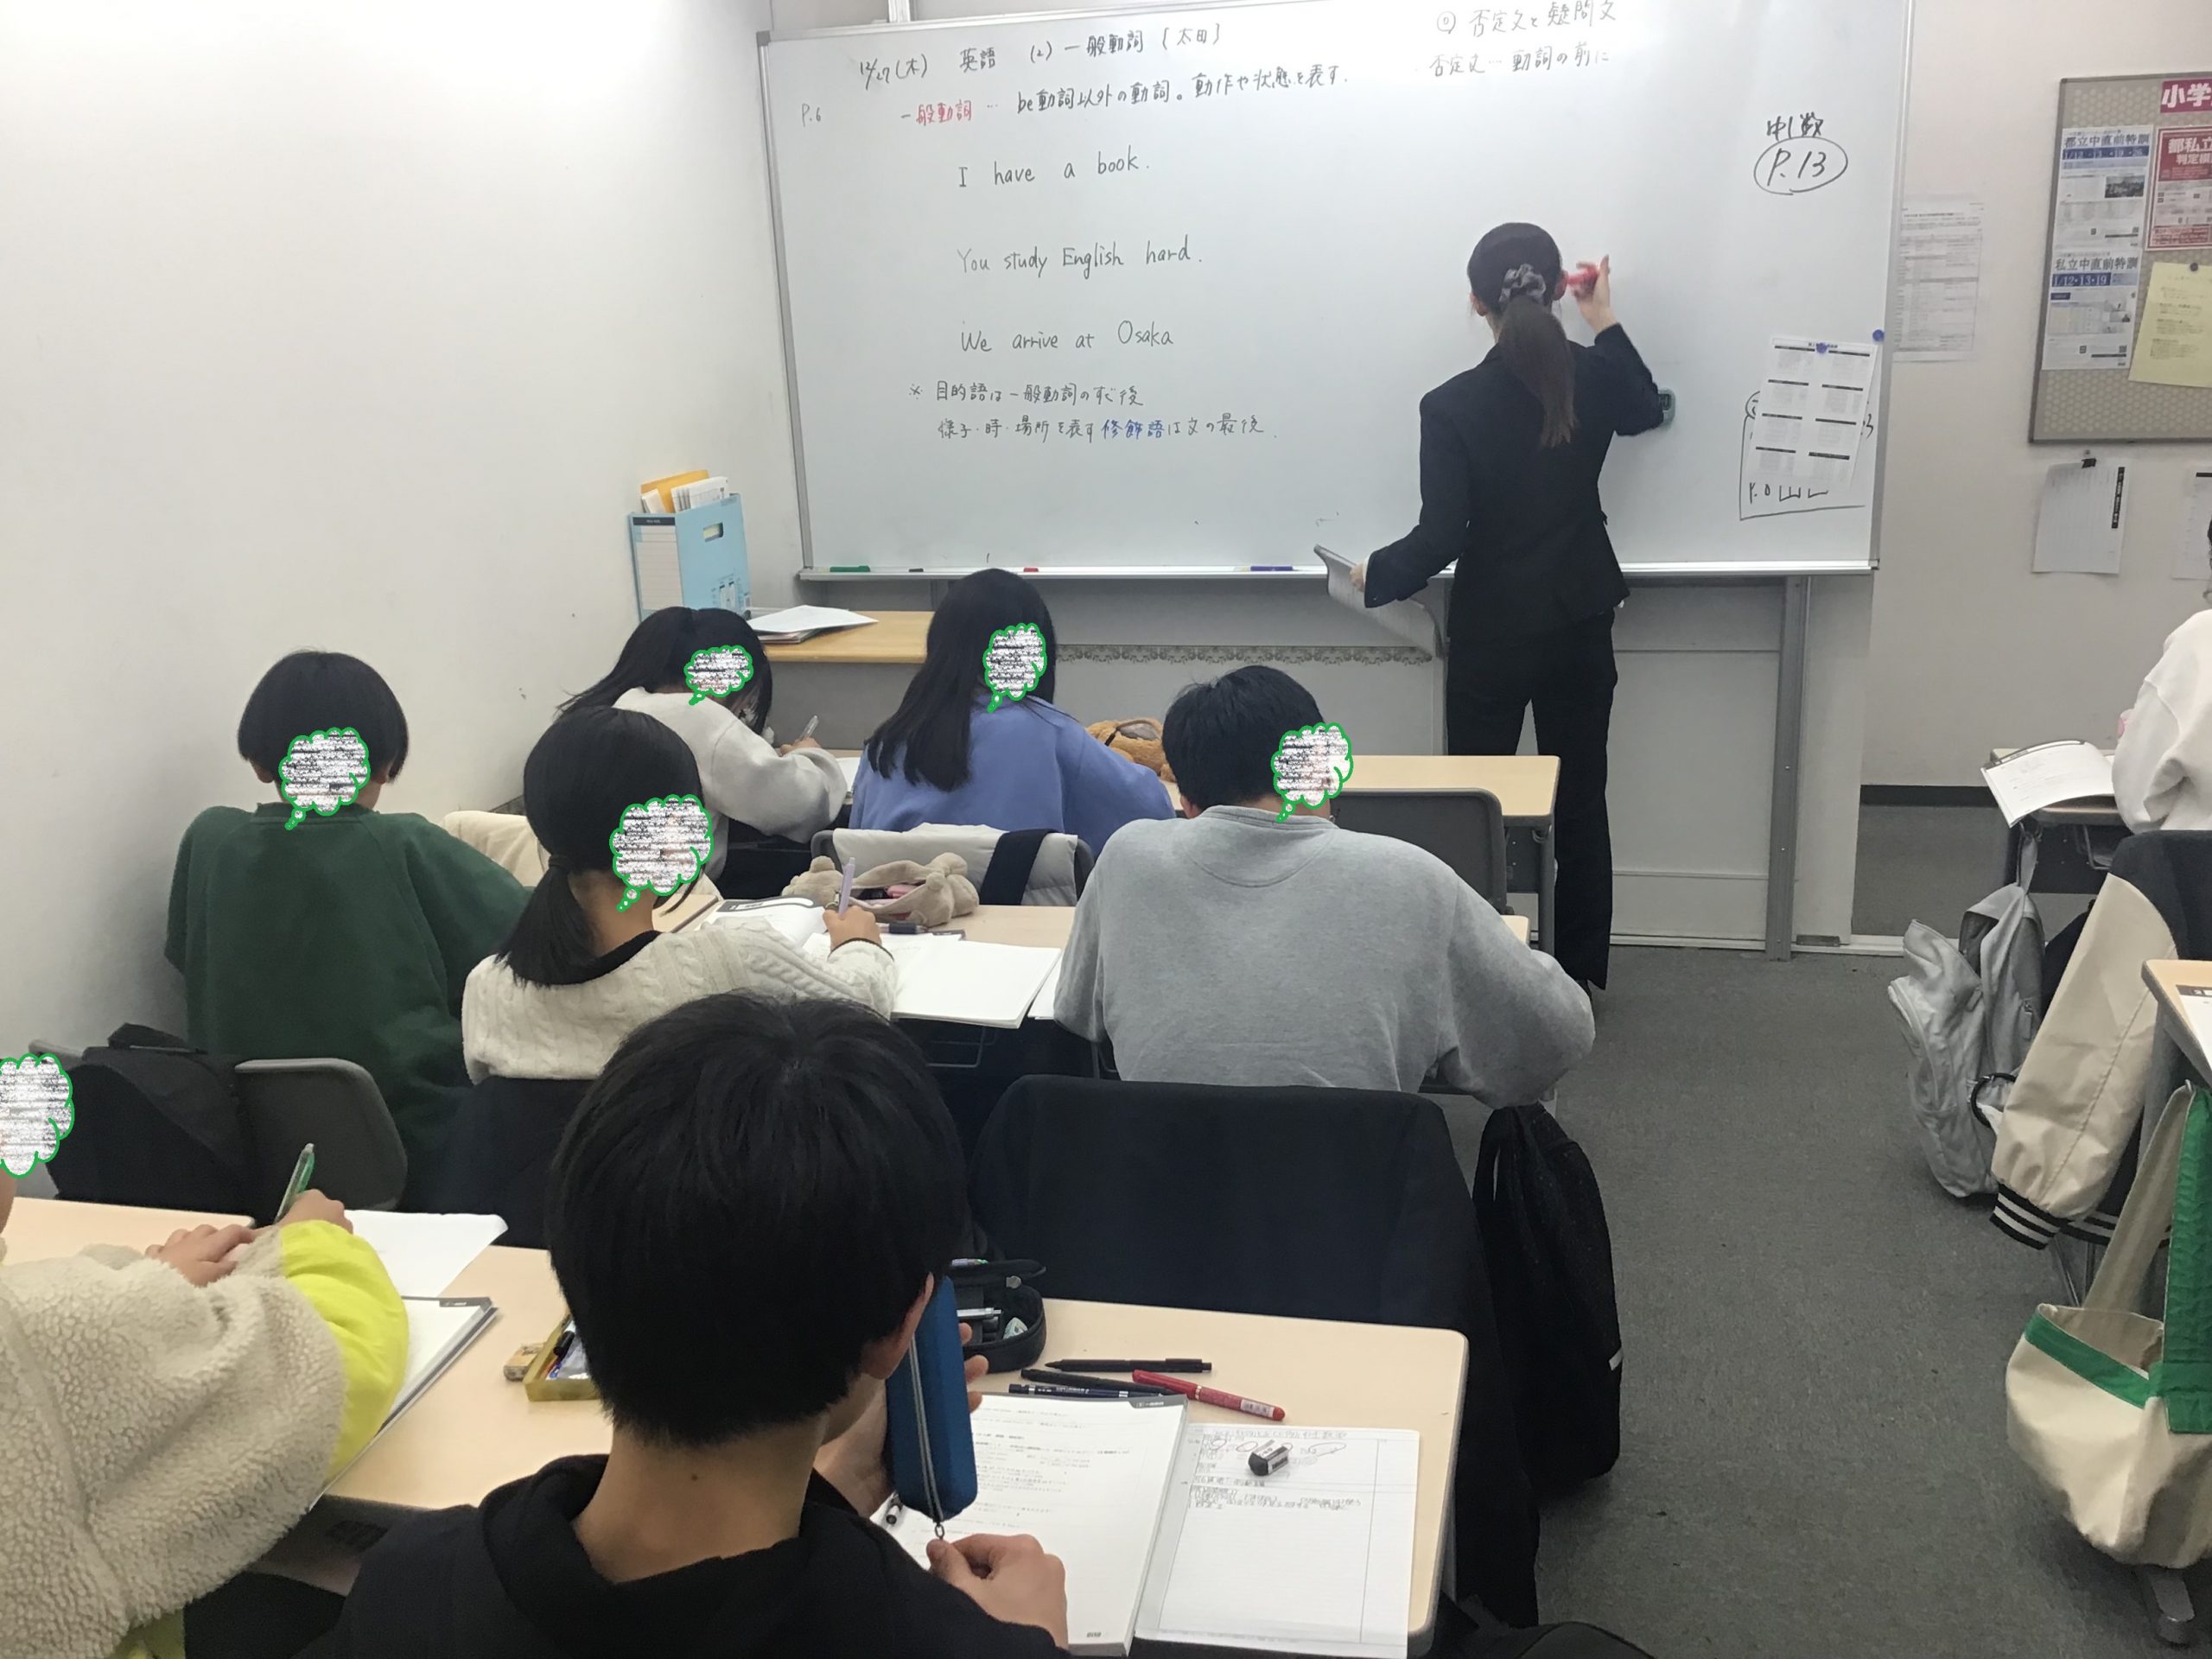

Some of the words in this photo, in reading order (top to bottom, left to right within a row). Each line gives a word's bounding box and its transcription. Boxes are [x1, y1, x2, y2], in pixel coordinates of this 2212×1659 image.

[960, 48, 995, 73] 英語
[1064, 30, 1144, 58] 一般動詞
[2162, 83, 2212, 108] 小学
[959, 167, 968, 188] I
[995, 161, 1035, 184] have
[1064, 162, 1075, 179] a
[957, 248, 990, 274] You
[1004, 246, 1047, 278] study
[1063, 241, 1124, 280] English
[961, 329, 992, 352] We
[1012, 332, 1058, 350] arrive
[1076, 334, 1095, 348] at
[1118, 321, 1173, 346] Osaka
